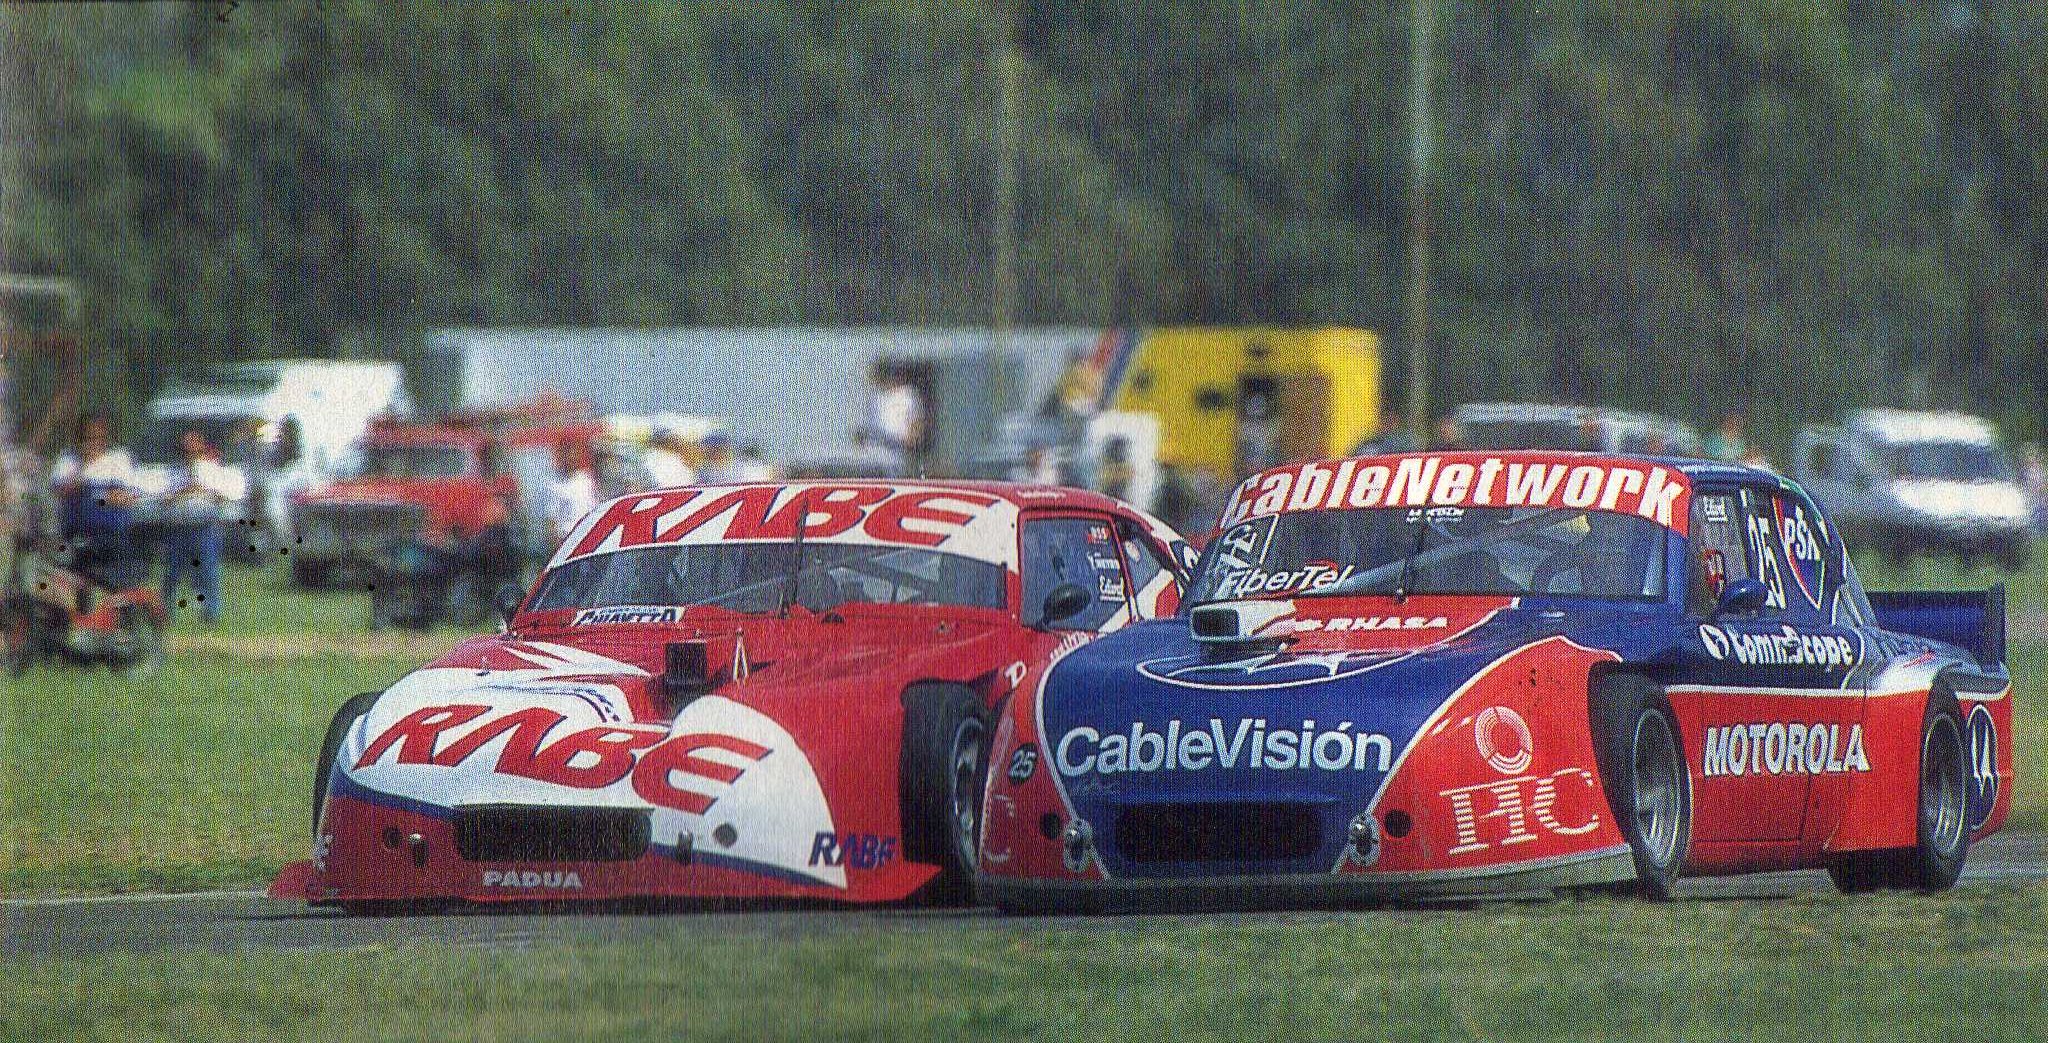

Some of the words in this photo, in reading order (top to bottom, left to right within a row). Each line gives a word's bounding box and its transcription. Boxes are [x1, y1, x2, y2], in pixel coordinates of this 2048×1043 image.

[1221, 457, 1685, 527] CableNetwork
[566, 486, 998, 560] RABE
[1214, 564, 1356, 600] FiberTel
[353, 702, 774, 815] RABE
[1008, 748, 1036, 778] 25
[1056, 718, 1393, 778] CableVisión
[1703, 722, 1870, 777] MOTOROLA
[1440, 767, 1600, 856] HC
[482, 871, 582, 889] PADUA
